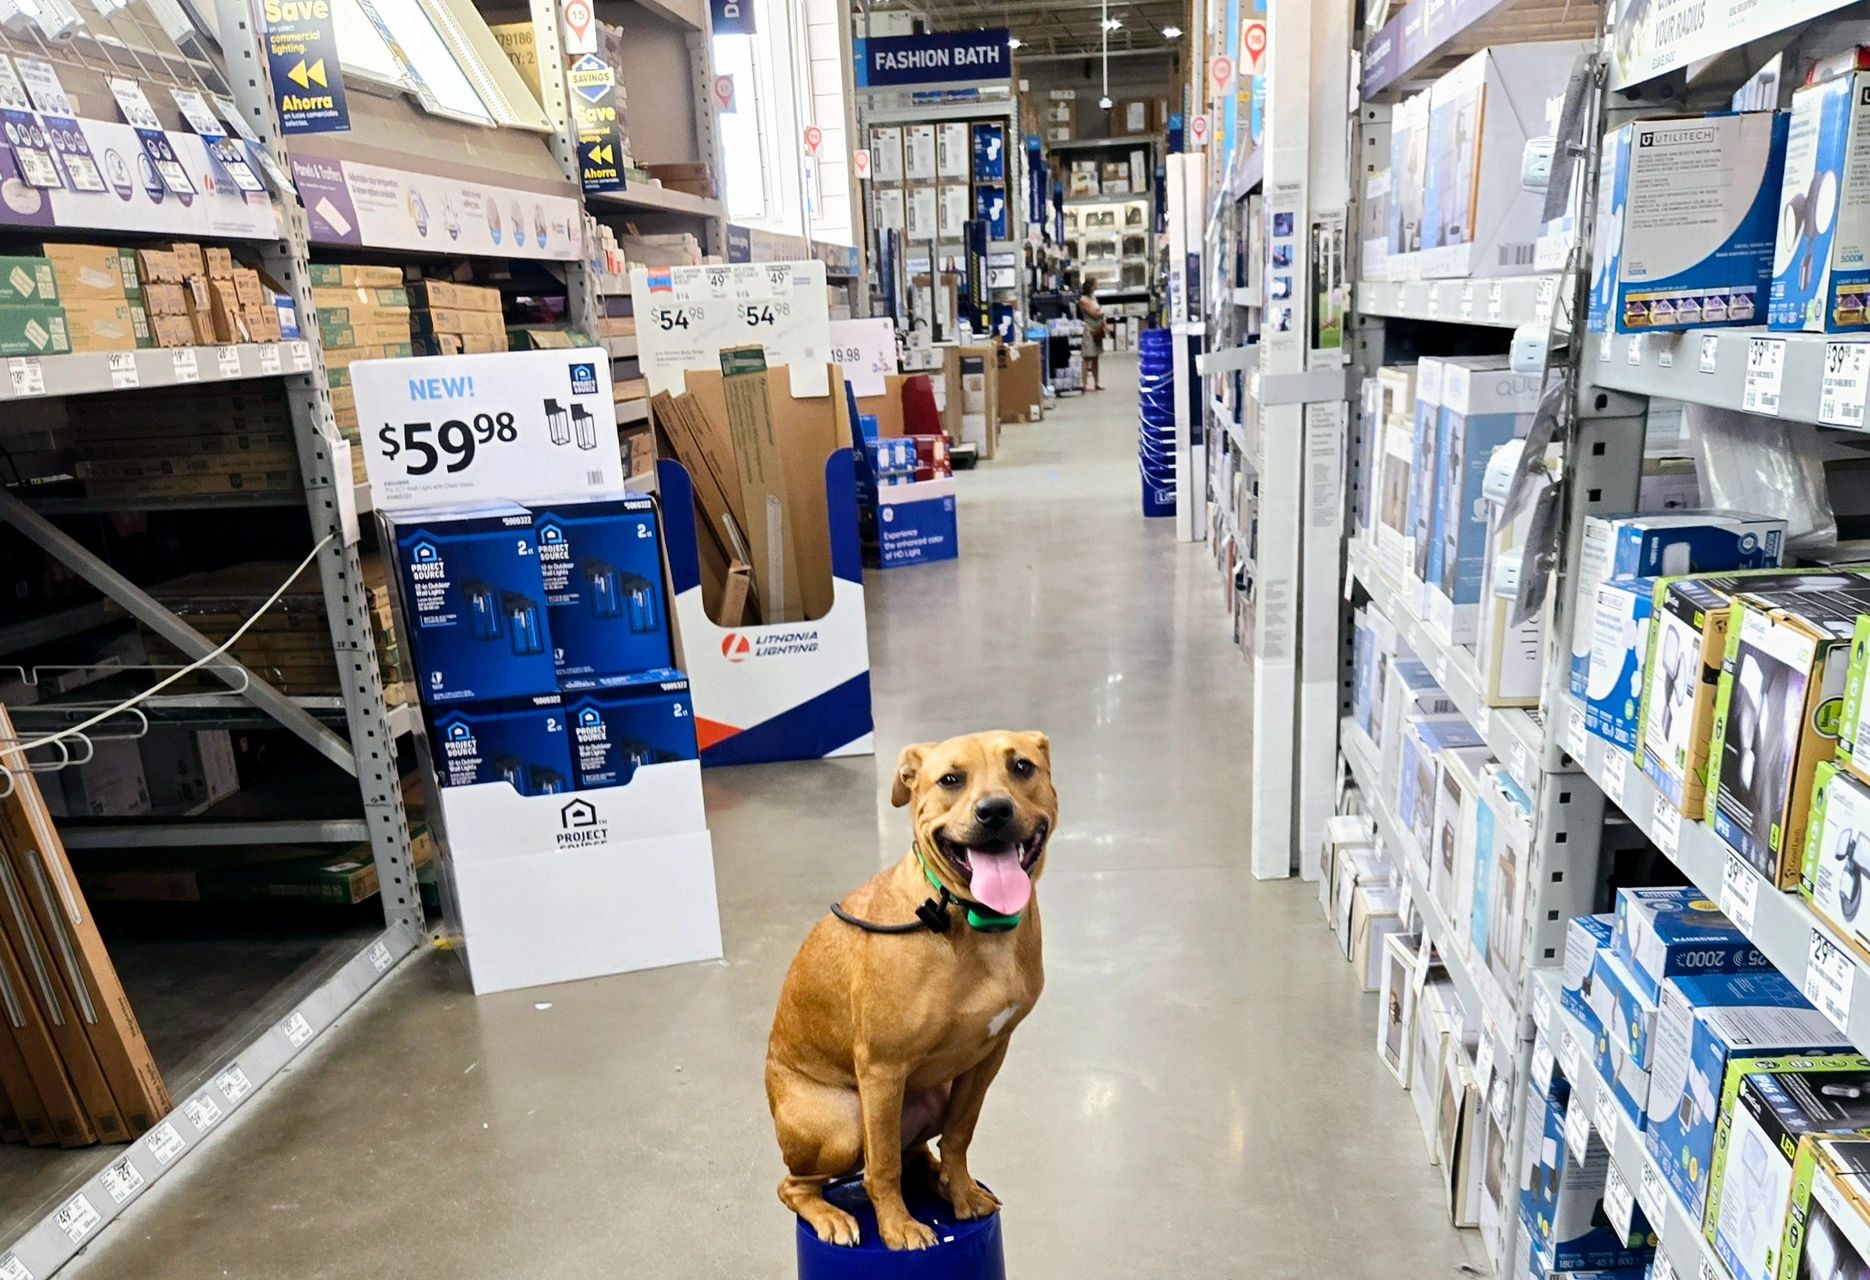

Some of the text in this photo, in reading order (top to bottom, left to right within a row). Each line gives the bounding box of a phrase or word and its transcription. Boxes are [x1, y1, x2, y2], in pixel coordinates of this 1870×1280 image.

[264, 0, 329, 23] Save
[270, 31, 320, 43] commercial
[1654, 15, 1676, 49] YOUR
[272, 43, 307, 56] lighting.
[874, 45, 1000, 71] FASHION BATH
[572, 73, 610, 84] SAVINGS
[283, 95, 334, 111] Ahorra
[575, 105, 616, 122] Save
[1655, 129, 1712, 144] UTILITECH
[584, 168, 617, 179] Ahorra
[408, 375, 476, 401] NEW!
[637, 524, 647, 538] 2
[883, 529, 918, 541] Experience
[517, 541, 528, 556] 2
[538, 543, 569, 554] PROJECT
[884, 542, 896, 550] the
[896, 537, 928, 549] enhanced
[540, 551, 570, 561] SOURCE
[411, 562, 444, 573] PROJECT
[413, 570, 445, 580] SOURCE
[755, 631, 818, 645] LITHONIA
[755, 642, 819, 657] LIGHTING
[673, 703, 683, 717] 2
[547, 718, 556, 733] 2
[576, 724, 607, 736] PROJECT
[577, 732, 607, 743] SOURCE
[445, 739, 477, 751] PROJECT
[447, 747, 477, 758] SOURCE
[556, 828, 608, 844] PROJECT
[1686, 951, 1726, 968] 2000
[1780, 1132, 1796, 1160] LED
